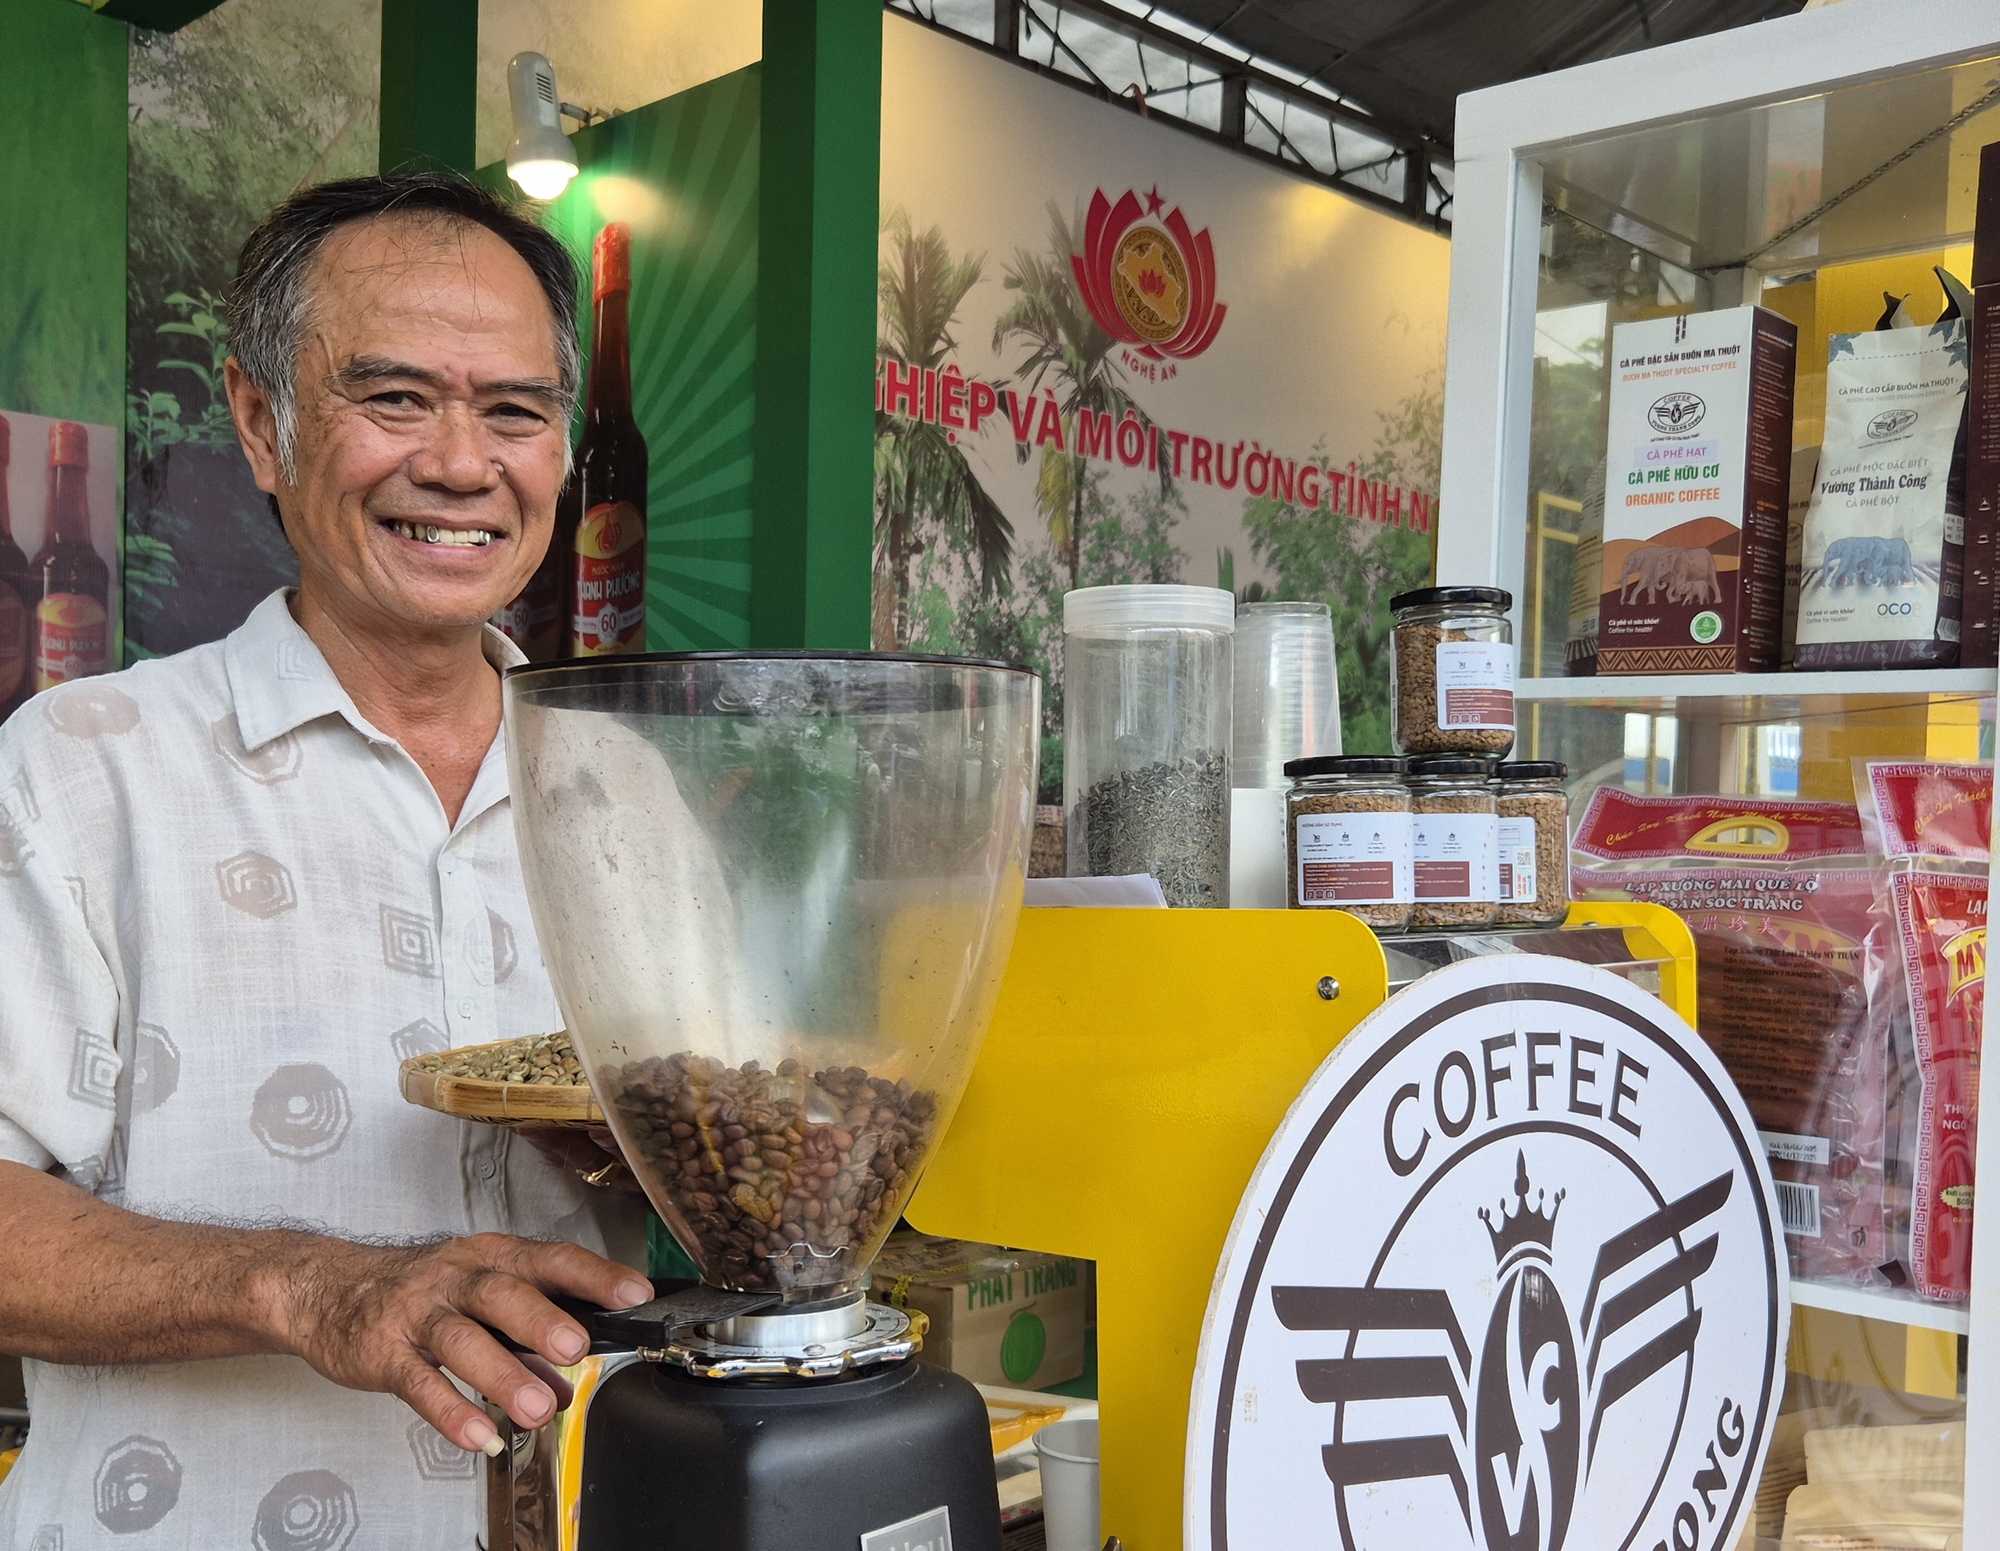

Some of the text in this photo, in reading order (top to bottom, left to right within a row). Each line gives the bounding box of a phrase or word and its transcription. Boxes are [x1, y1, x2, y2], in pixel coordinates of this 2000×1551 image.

[1704, 348, 1716, 358] MA
[1161, 364, 1178, 382] AN
[1641, 372, 1651, 380] MA
[1674, 364, 1710, 376] SPECIALTY
[1711, 361, 1737, 372] COFFEE
[1865, 386, 1880, 394] CAO
[1896, 382, 1918, 392] BUÔN
[1920, 380, 1930, 388] MA
[1931, 376, 1954, 386] THUỘT
[1925, 389, 1946, 398] COFFEE
[1663, 395, 1692, 404] COFFEE
[876, 360, 997, 444] HIỆP
[1008, 388, 1065, 452] VÀ
[1077, 405, 1158, 473] MÔI
[1166, 429, 1319, 511] TRƯỜNG
[1326, 461, 1400, 527] TỈNH
[1646, 446, 1707, 460] CÀ PHÊ HẠT
[1648, 466, 1670, 483] PHÊ
[1674, 465, 1698, 481] HỮU
[1702, 463, 1720, 478] CƠ
[1863, 462, 1885, 472] MỘC
[1821, 473, 1928, 496] Vương Thành Công
[1626, 488, 1720, 507] ORGANIC COFFEE
[1860, 496, 1878, 506] PHÊ
[1880, 494, 1900, 506] BỘT
[514, 608, 528, 626] 60
[601, 612, 617, 633] 60
[1623, 882, 1656, 895] LẠP
[1659, 876, 1716, 892] XƯỞNG
[1719, 878, 1751, 890] MAI
[1754, 878, 1794, 891] QUẾ
[1796, 876, 1820, 893] LỘ
[1669, 894, 1701, 910] SẢN
[1704, 895, 1737, 909] SÓC
[1742, 896, 1804, 911] TRĂNG
[1822, 950, 1836, 960] MỸ
[1383, 1029, 1650, 1177] COFFEE
